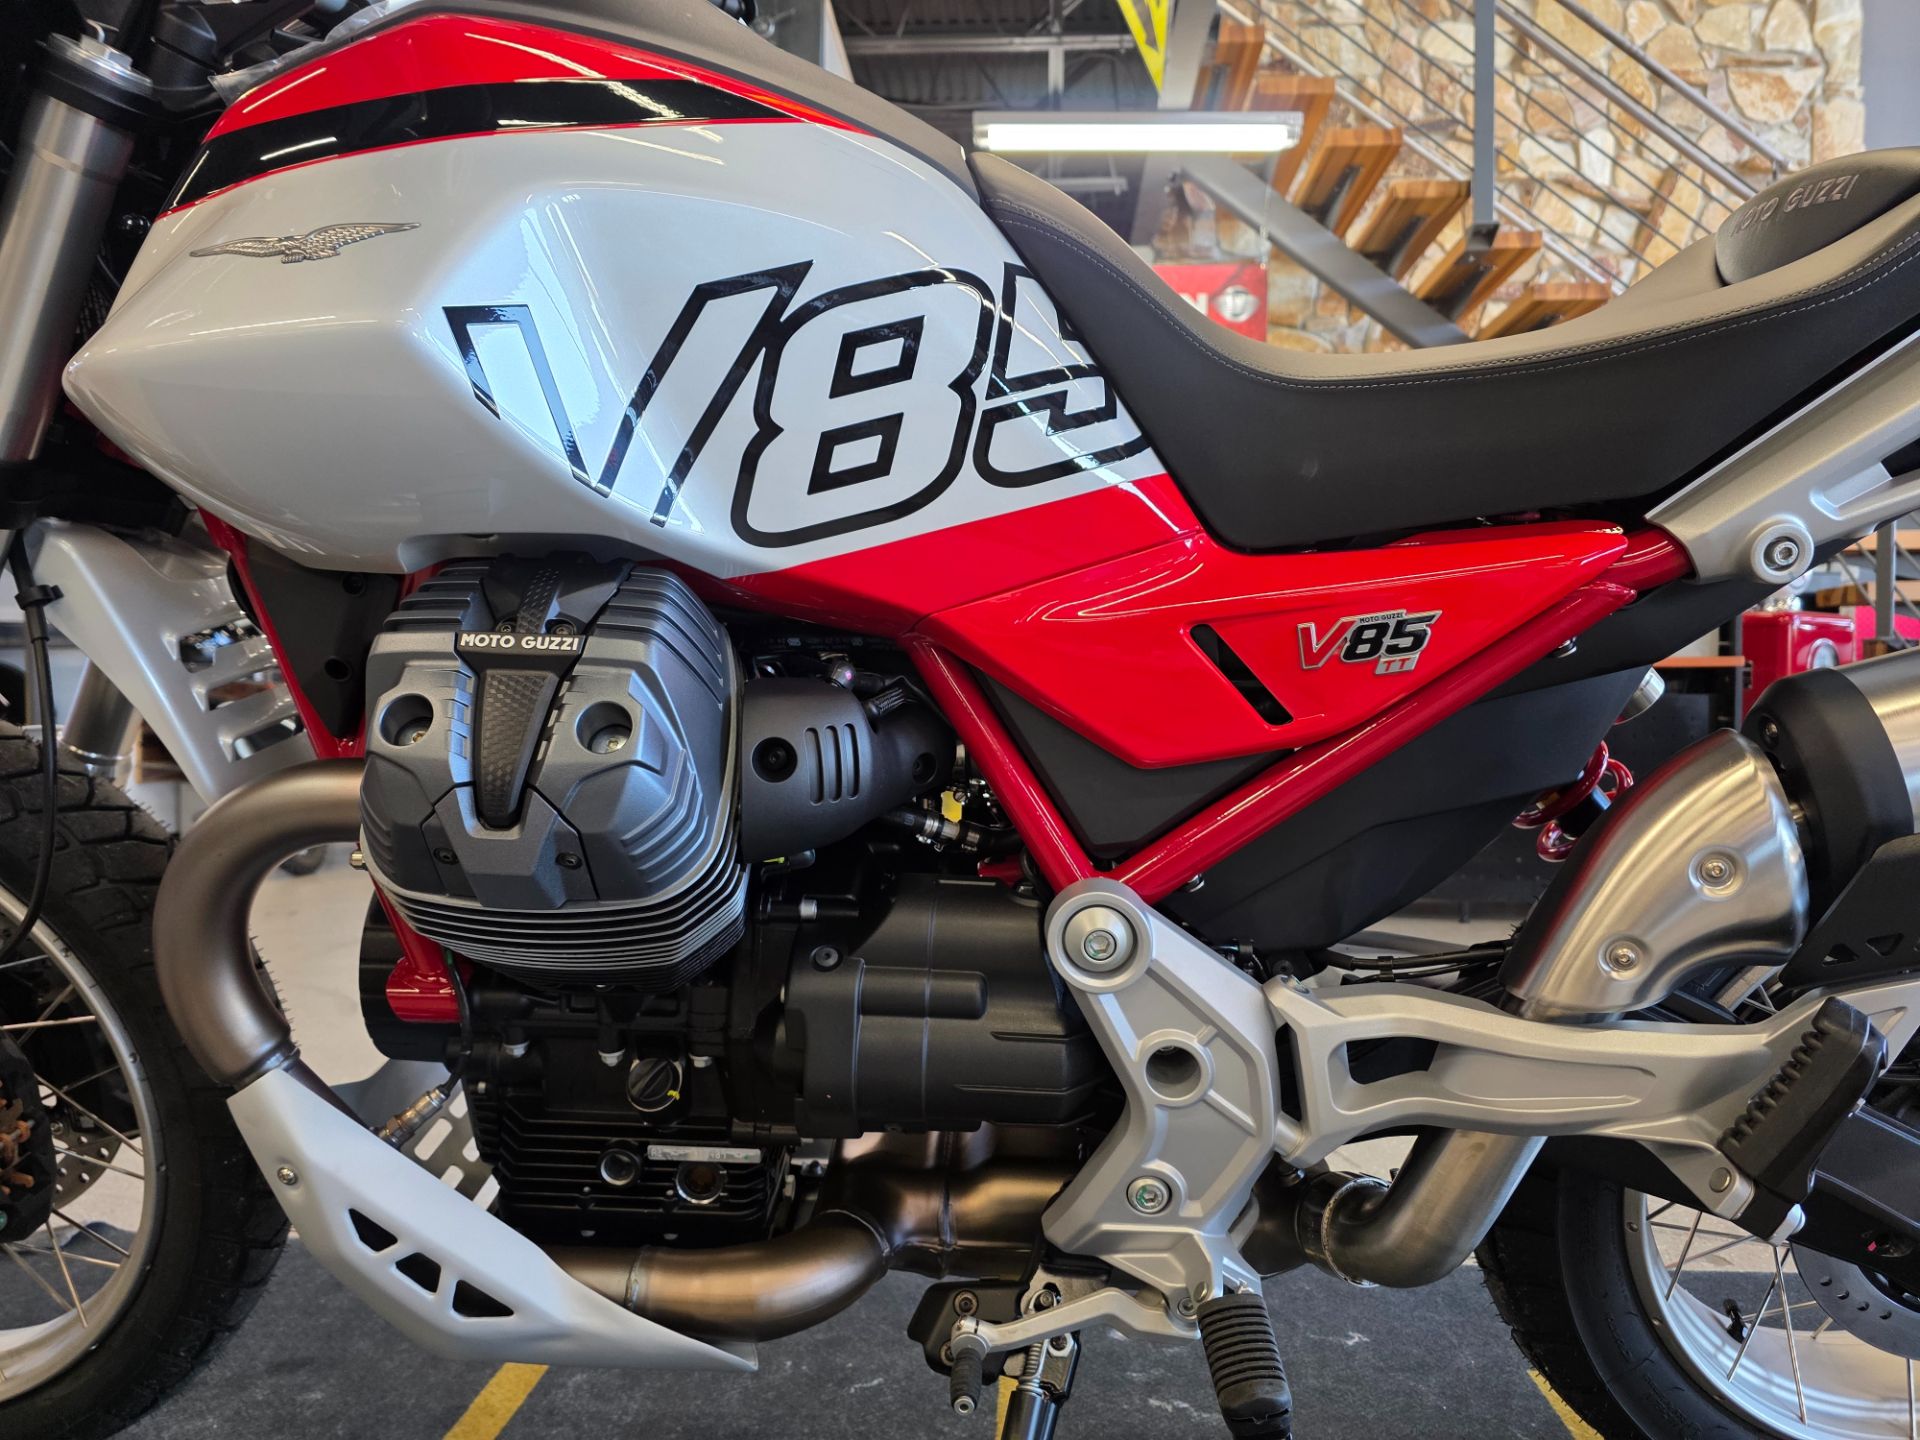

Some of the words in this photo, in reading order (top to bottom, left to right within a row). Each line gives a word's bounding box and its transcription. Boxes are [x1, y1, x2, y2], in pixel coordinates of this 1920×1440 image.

[1783, 174, 1860, 212] GUZZI
[1359, 614, 1380, 624] MOTO
[1381, 612, 1404, 621] GUZZI
[460, 633, 515, 648] MOTO
[521, 635, 579, 651] GUZZI
[1298, 609, 1442, 669] V85
[1383, 657, 1411, 672] TT
